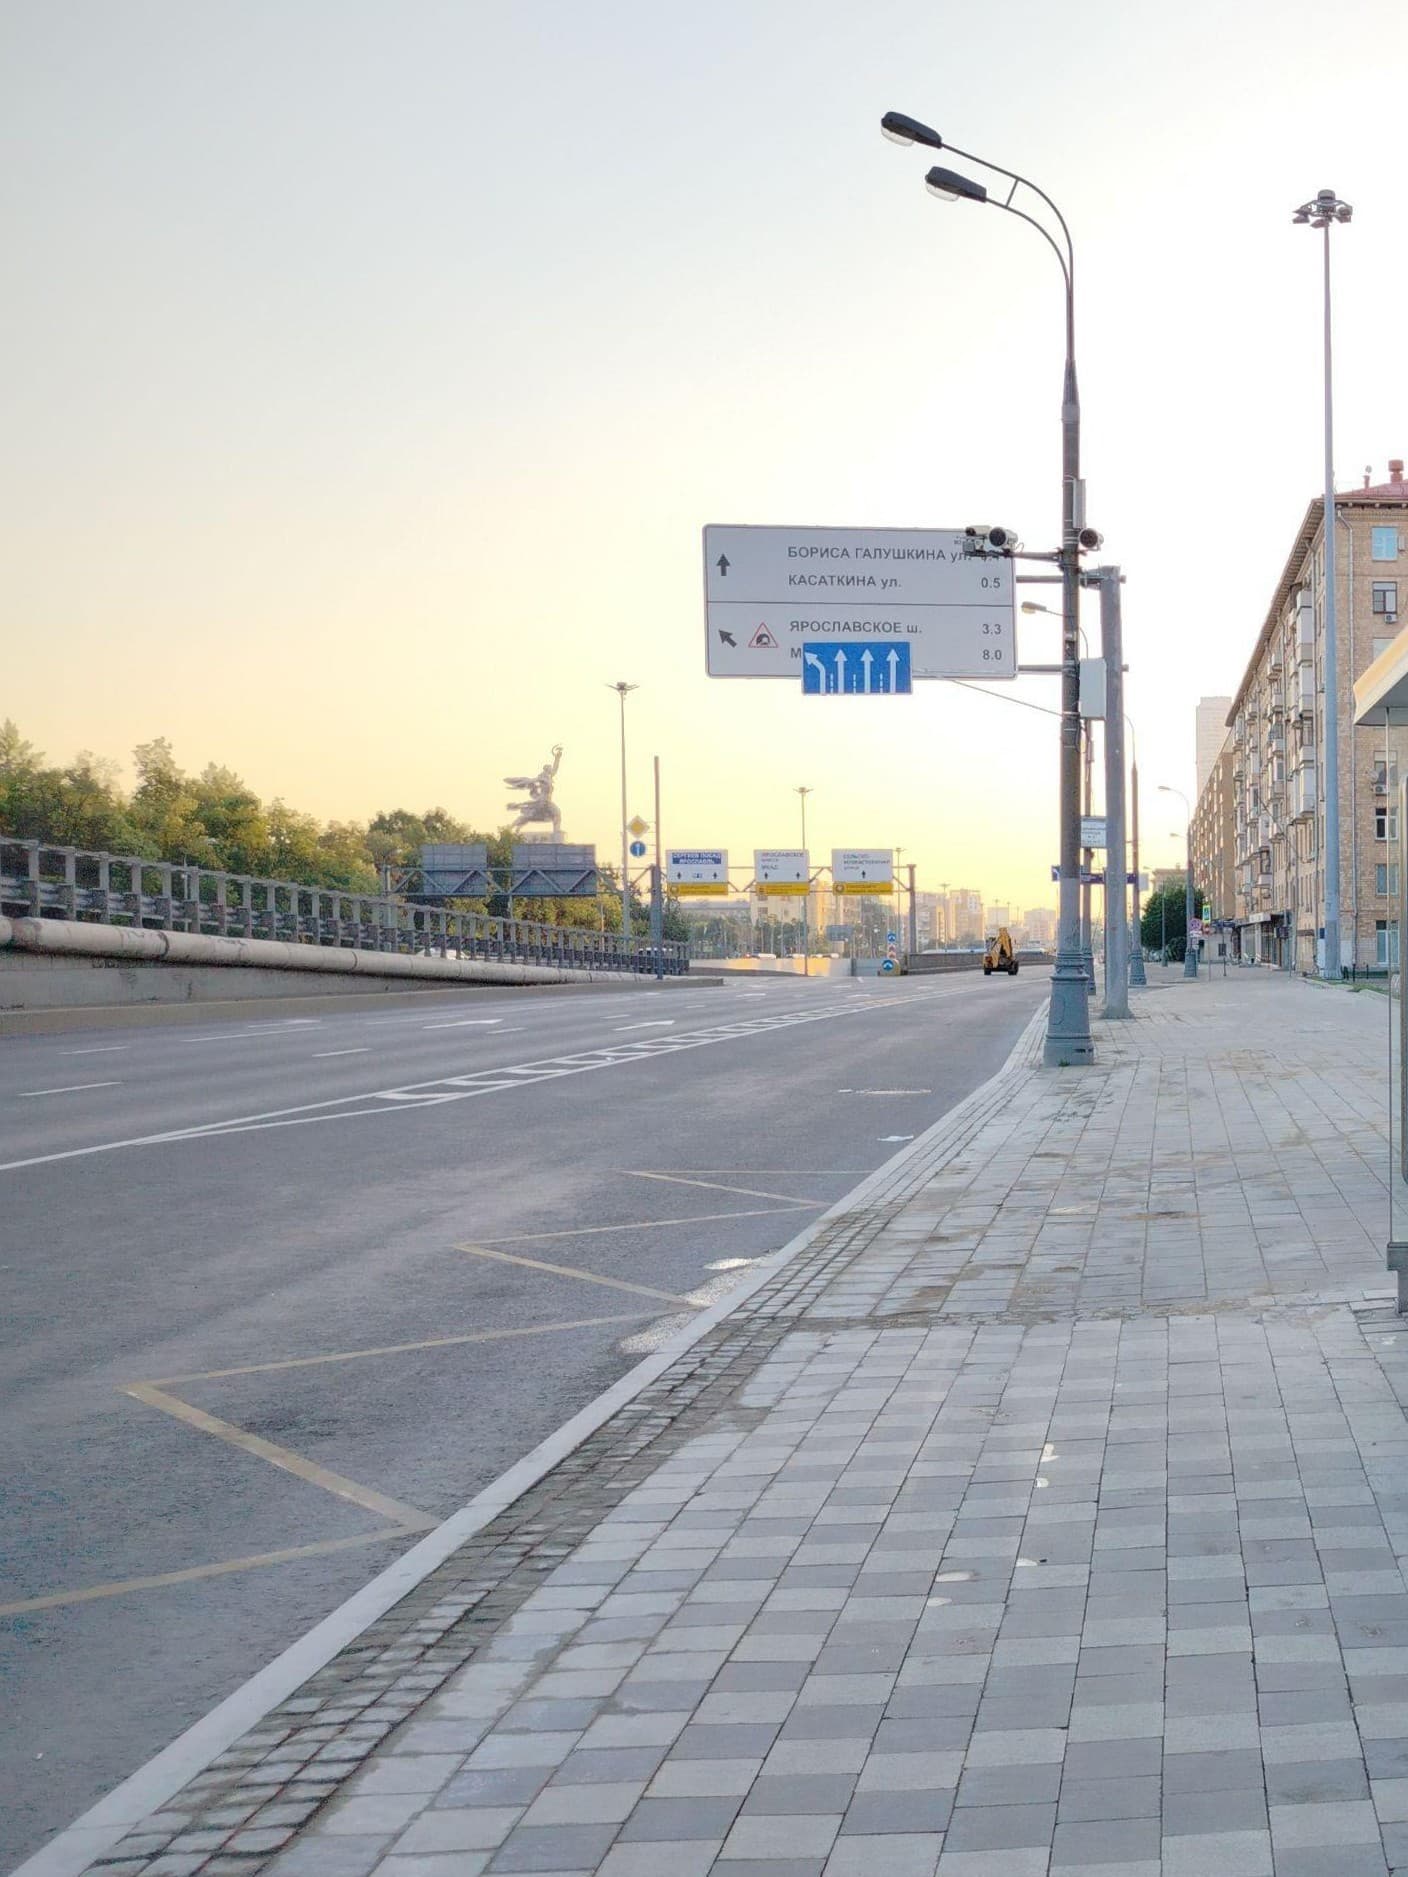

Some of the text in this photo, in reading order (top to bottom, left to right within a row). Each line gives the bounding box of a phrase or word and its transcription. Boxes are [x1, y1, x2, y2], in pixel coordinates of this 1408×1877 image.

[787, 546, 850, 559] БОРИСА
[855, 547, 946, 561] ГАЛУШКИНА
[788, 574, 902, 590] КАСАТКИНА ул.
[981, 577, 1001, 589] 0.5
[789, 620, 923, 634] ЯРОСЛАВСКОЕ ш.
[982, 623, 1002, 635] 3.3
[982, 649, 1002, 661] 8.0
